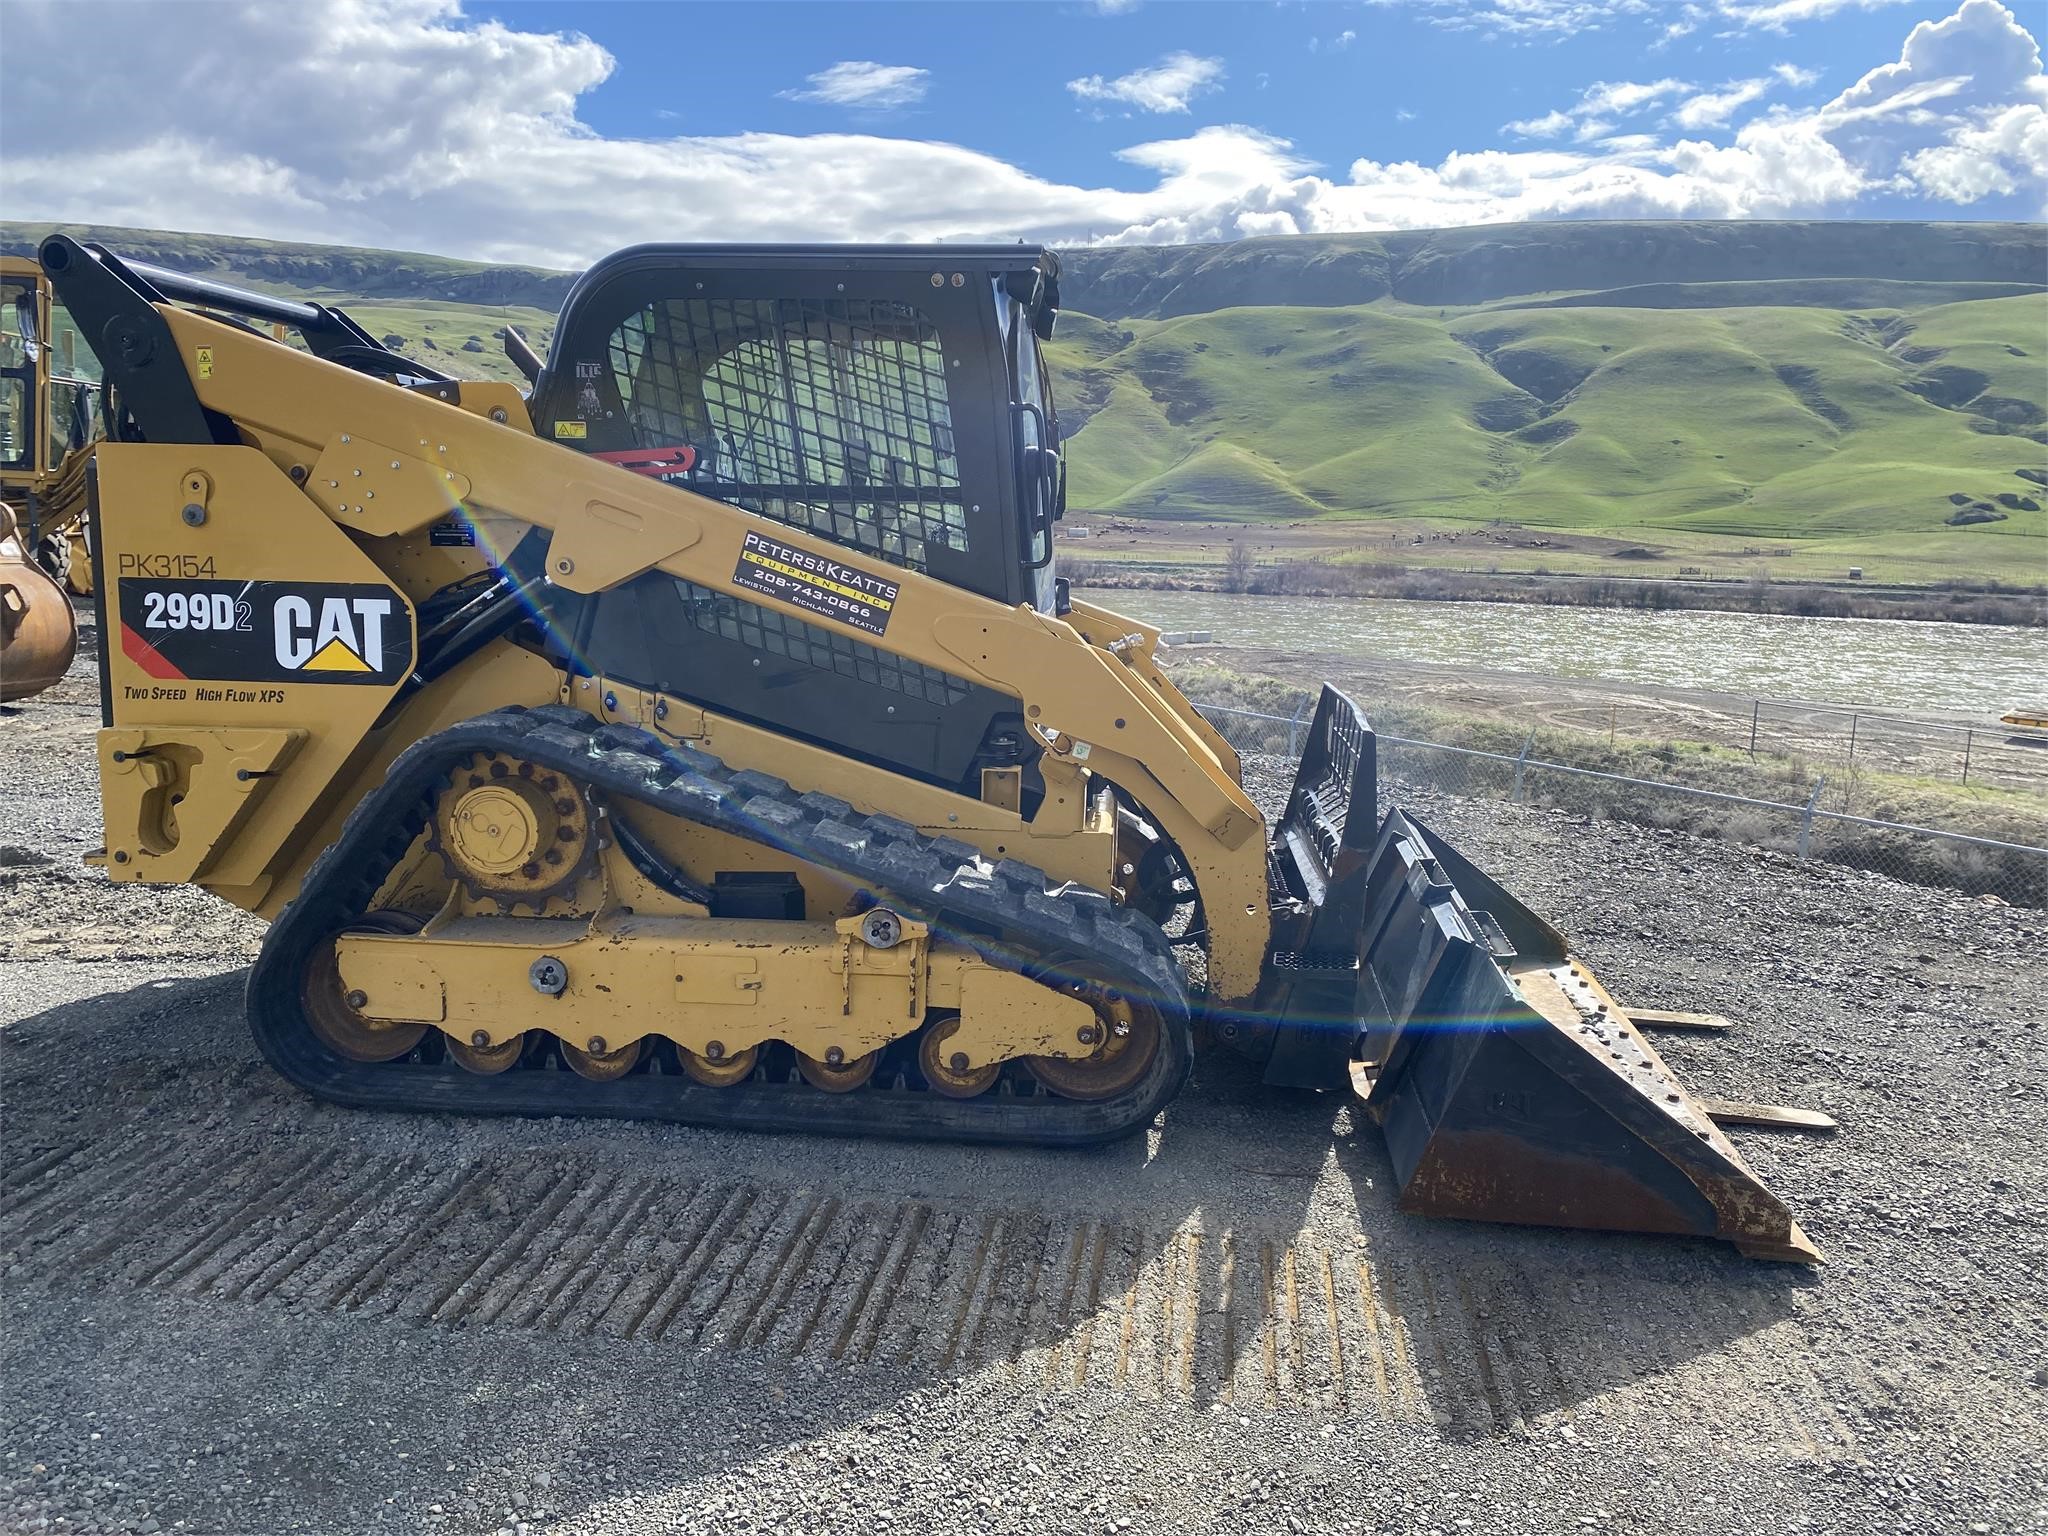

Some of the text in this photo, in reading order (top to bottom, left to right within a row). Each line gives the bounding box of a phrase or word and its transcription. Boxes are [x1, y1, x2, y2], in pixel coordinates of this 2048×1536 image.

[119, 553, 217, 578] PK3154
[744, 552, 889, 609] EQUIPMENT INC.
[144, 592, 253, 631] 299D2
[733, 576, 884, 634] LEWISTON RICHLAND SEATTLE
[753, 569, 871, 617] 208-743-0866
[273, 595, 391, 672] CAT
[124, 686, 285, 703] TWO SPEED HIGH FLOW XPS
